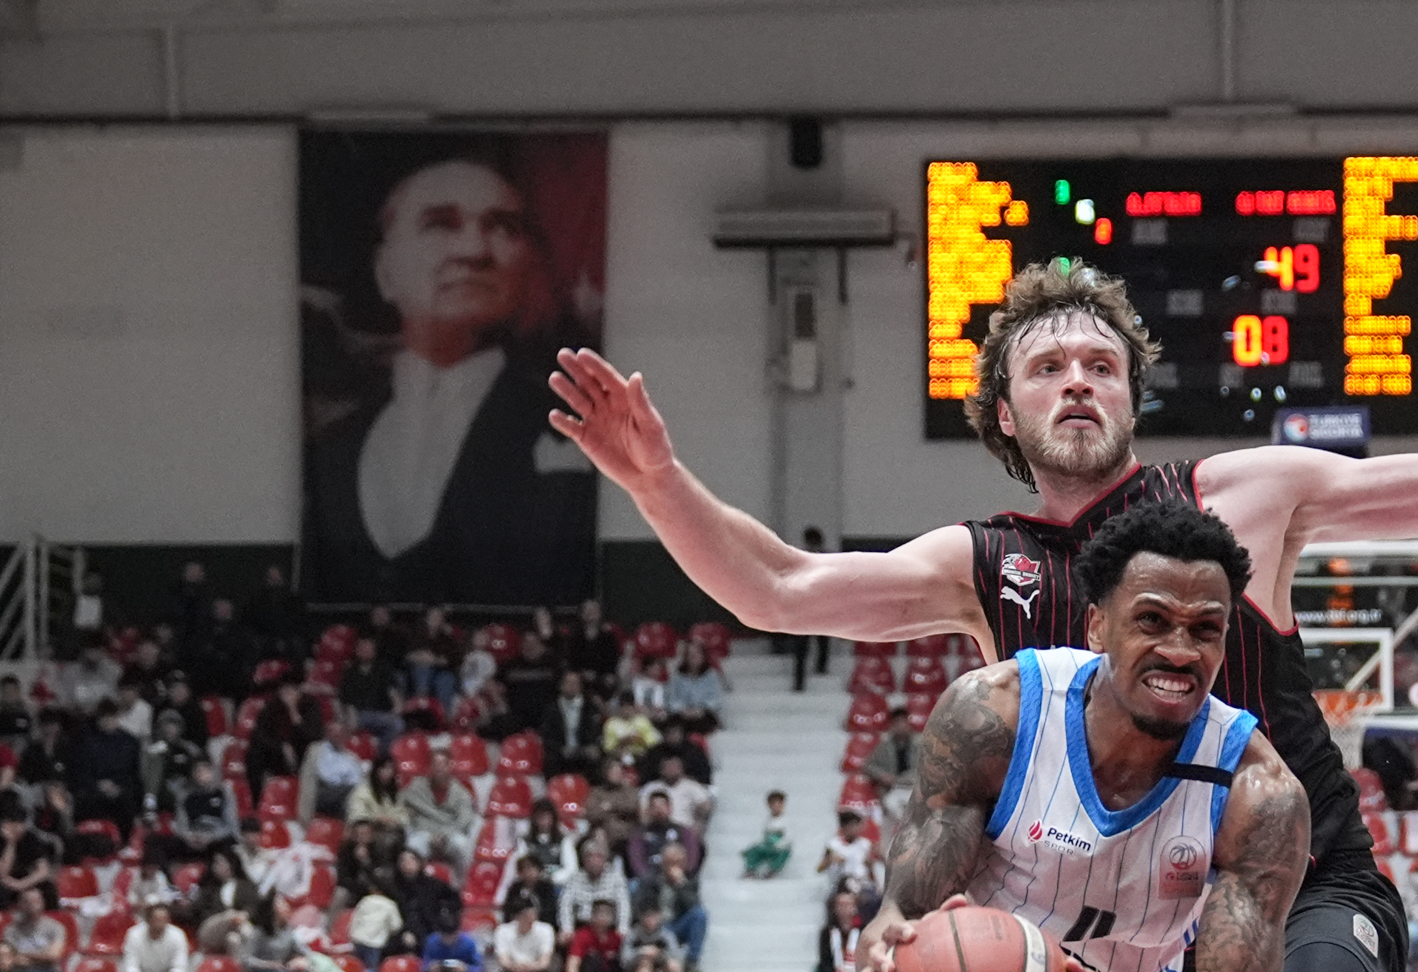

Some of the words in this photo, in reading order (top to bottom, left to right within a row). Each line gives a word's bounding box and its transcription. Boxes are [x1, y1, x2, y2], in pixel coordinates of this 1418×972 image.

[1264, 245, 1320, 293] 49
[1233, 315, 1289, 366] 08
[1044, 841, 1074, 855] SPOR
[1047, 827, 1091, 852] Petkim
